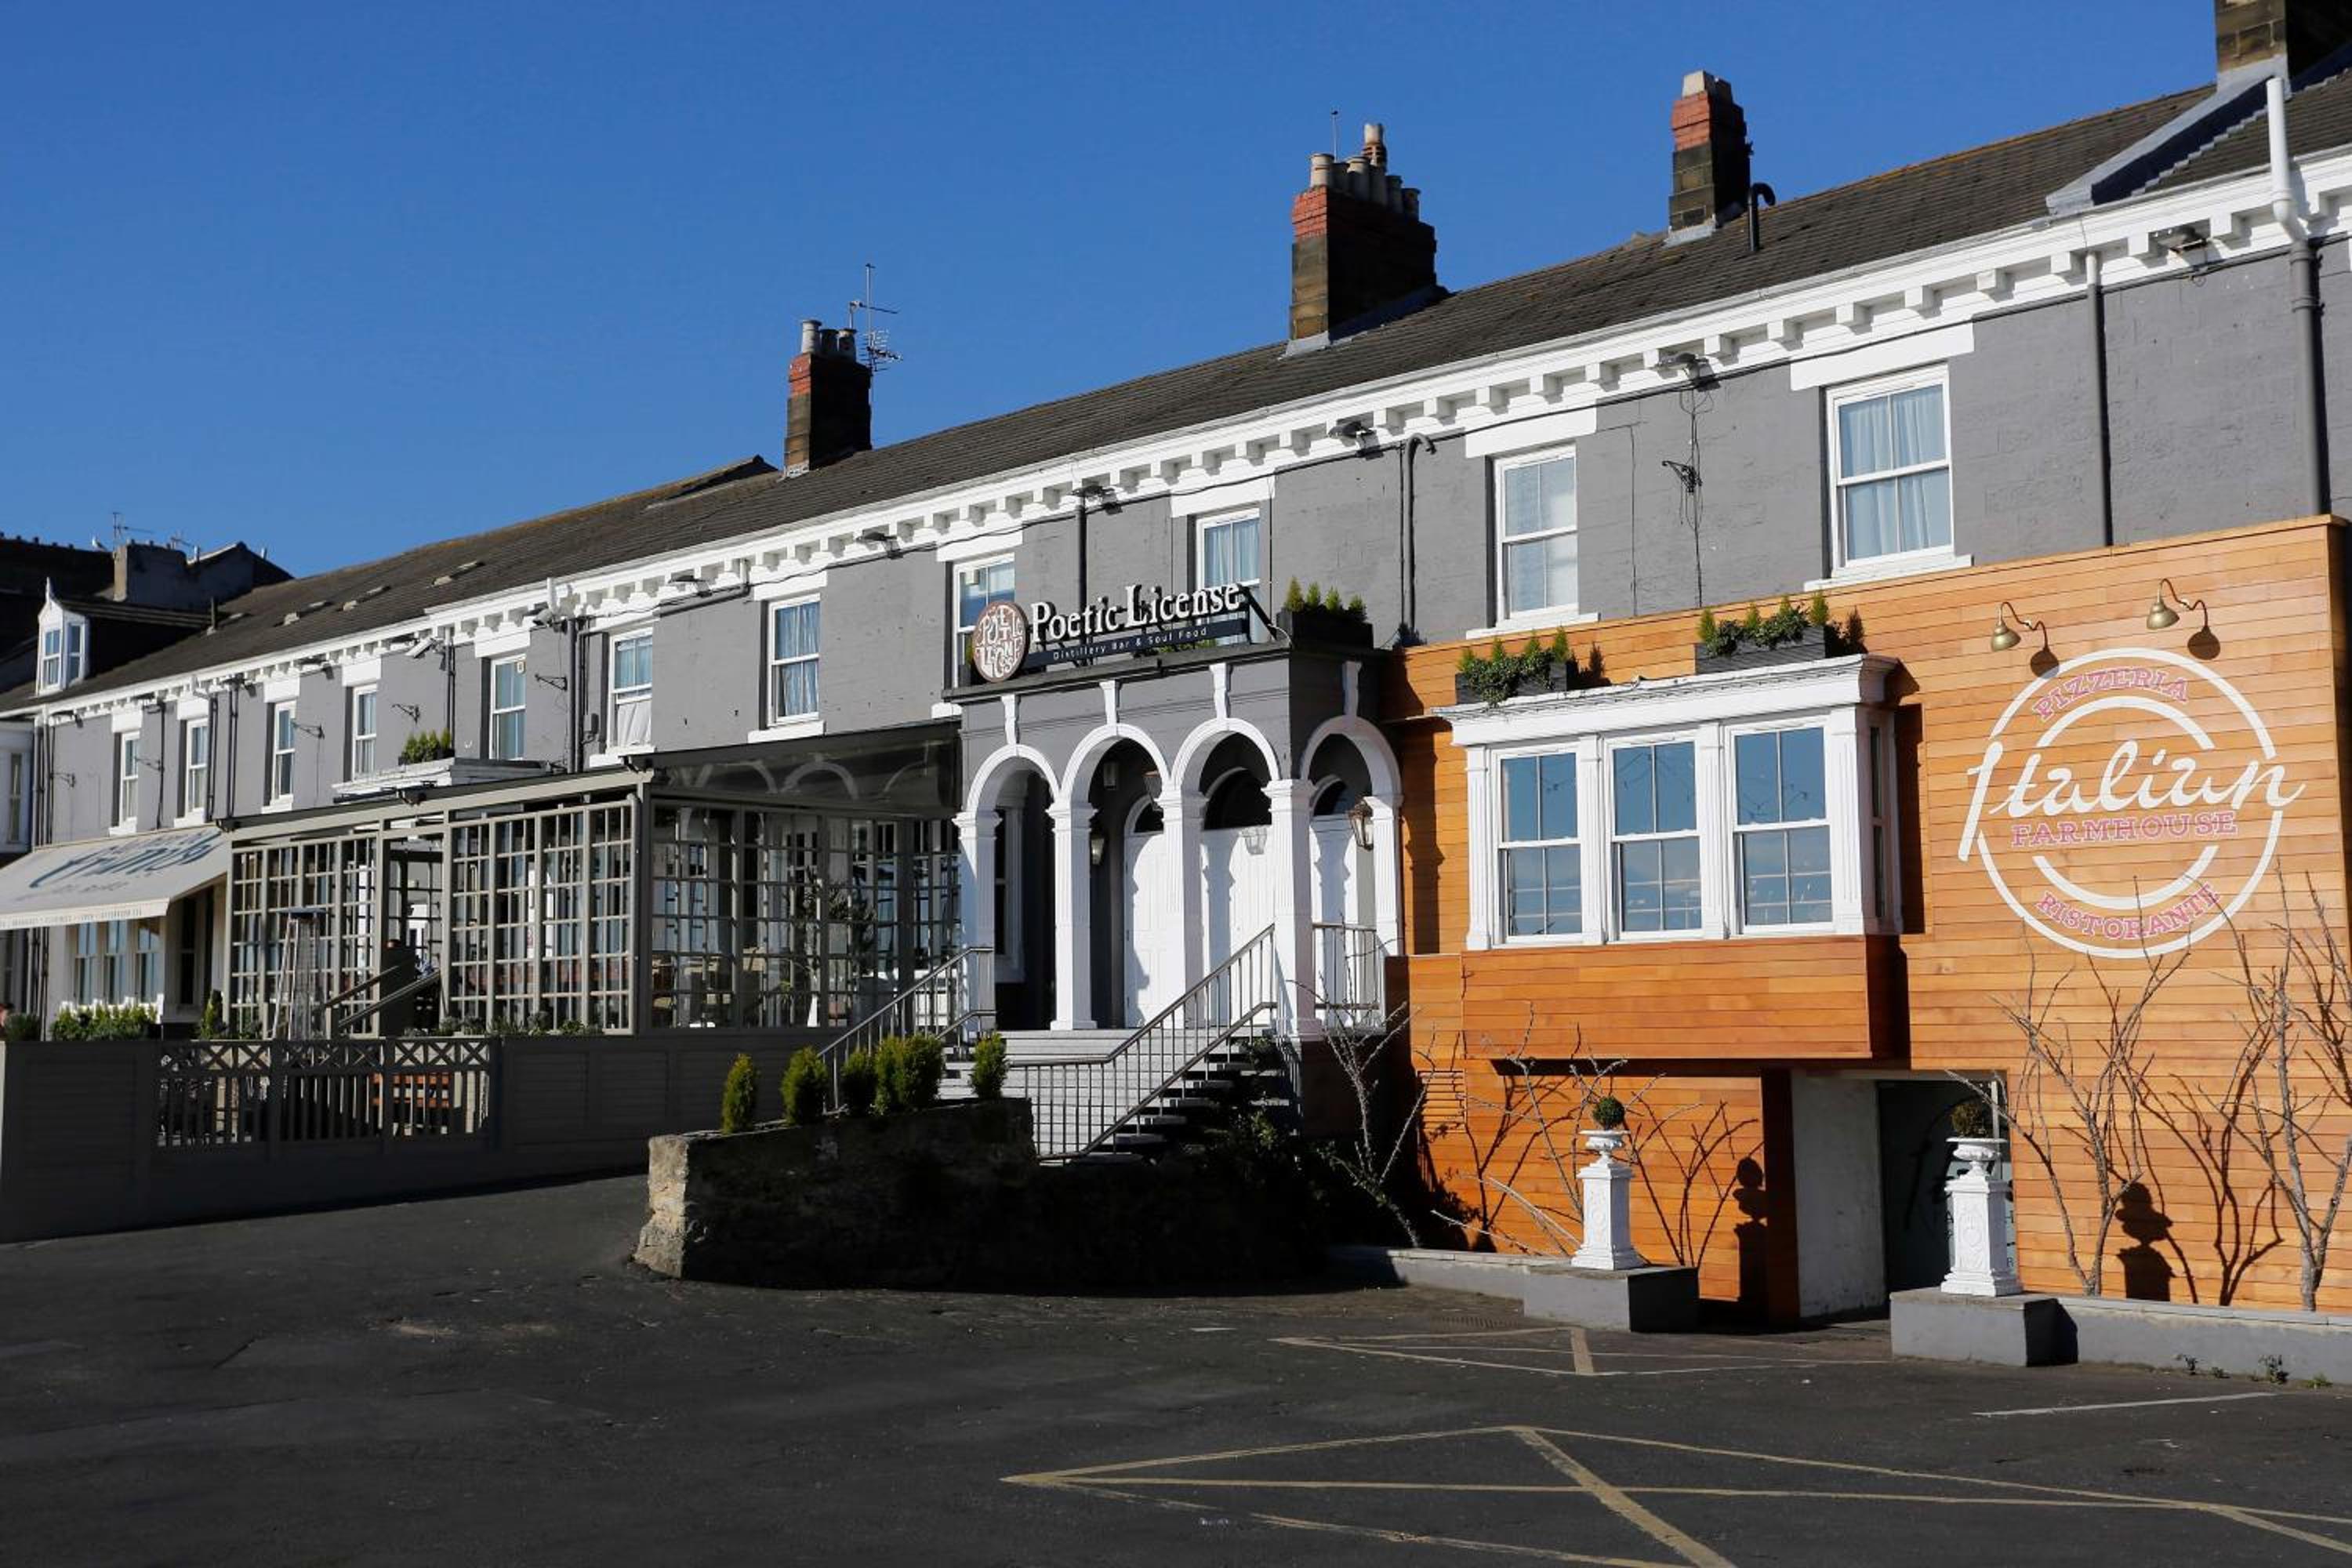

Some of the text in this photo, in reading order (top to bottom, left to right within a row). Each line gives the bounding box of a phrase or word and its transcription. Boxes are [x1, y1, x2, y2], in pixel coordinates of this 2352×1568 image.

[1031, 583, 1240, 643] Poetic License
[1053, 626, 1207, 660] Distillery Bar & Soul Food
[2033, 666, 2190, 720] PIZZERIA
[1958, 740, 2307, 862] Italian
[2011, 811, 2238, 848] FARMHOUSE
[2036, 883, 2221, 939] RISTORANTE
